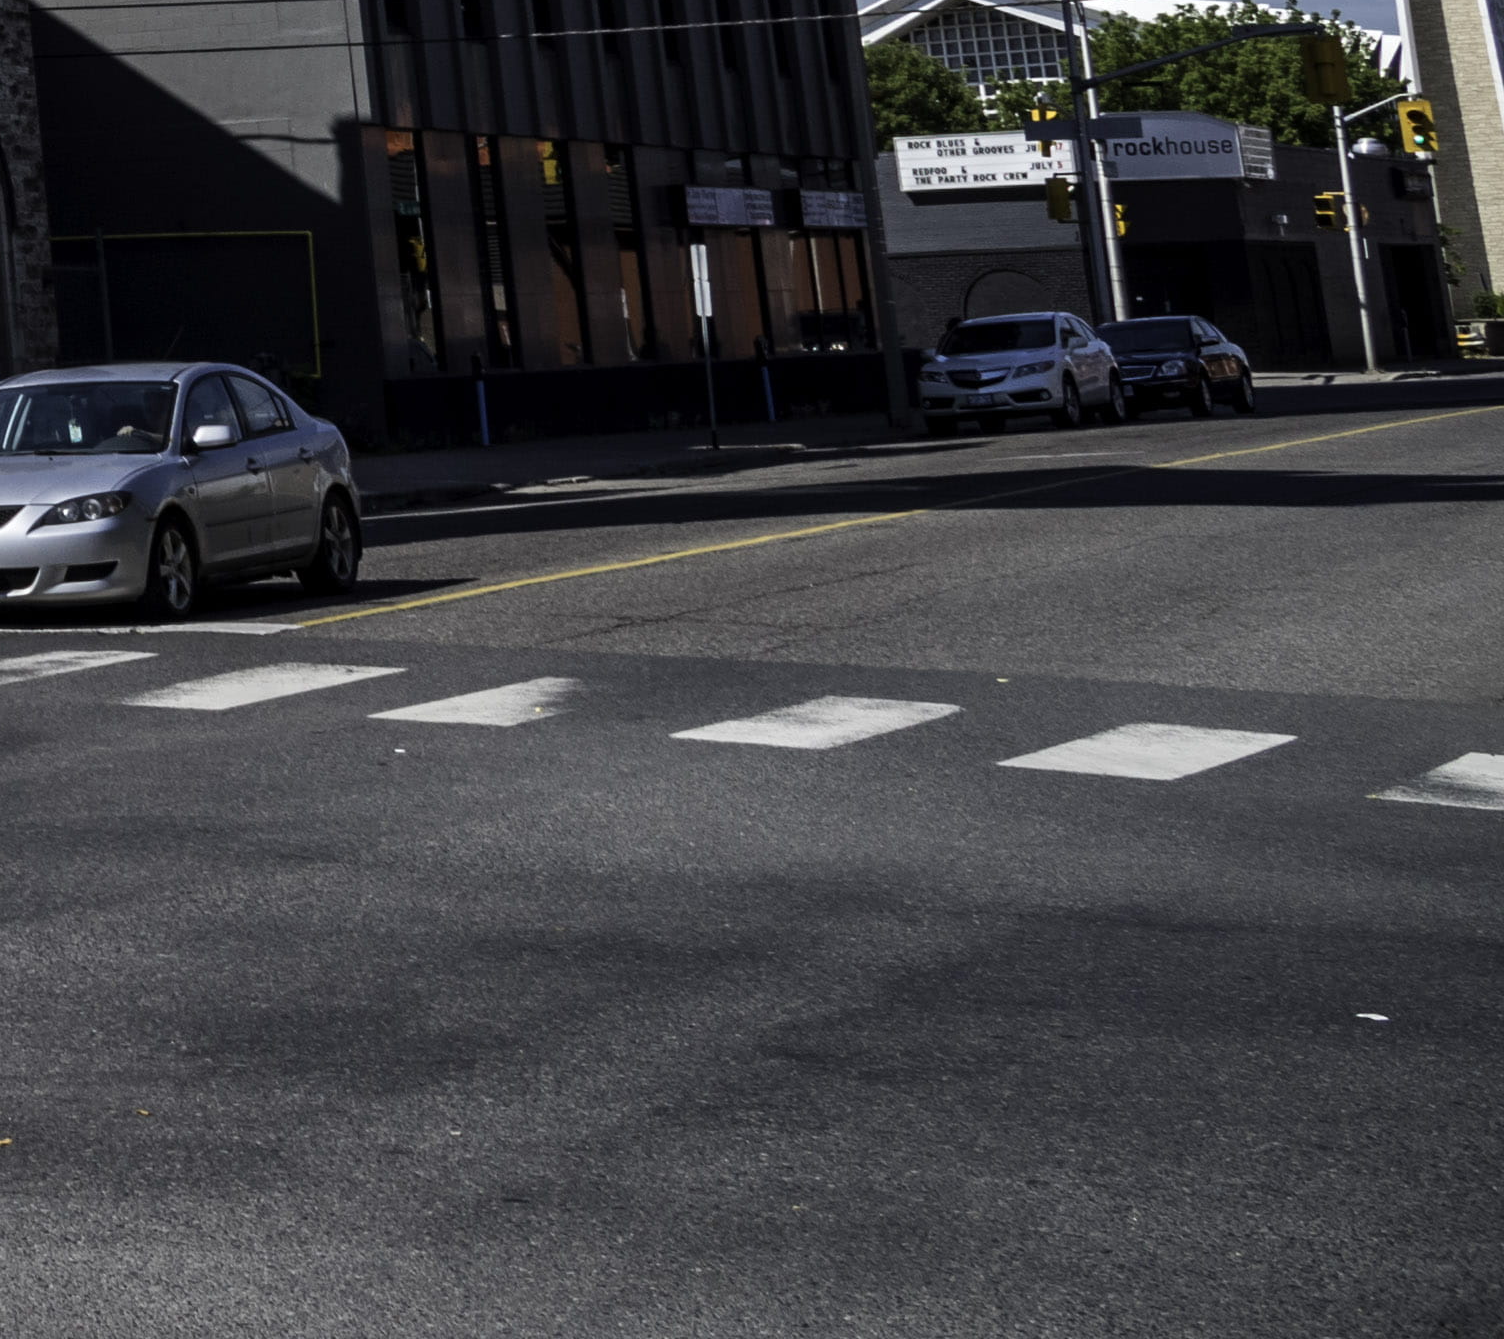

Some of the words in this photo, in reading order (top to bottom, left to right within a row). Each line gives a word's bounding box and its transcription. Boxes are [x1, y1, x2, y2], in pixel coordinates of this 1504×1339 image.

[907, 141, 931, 150] ROCK
[936, 139, 965, 148] BLUES
[1113, 136, 1234, 157] rockhouse
[937, 148, 966, 157] OTHER
[972, 145, 1015, 155] GROOVES
[912, 167, 947, 176] REDFOO
[1030, 161, 1053, 170] JULY
[915, 176, 932, 184] THE
[938, 175, 968, 183] PARTY
[973, 173, 997, 182] ROCK
[1003, 172, 1028, 181] CREW
